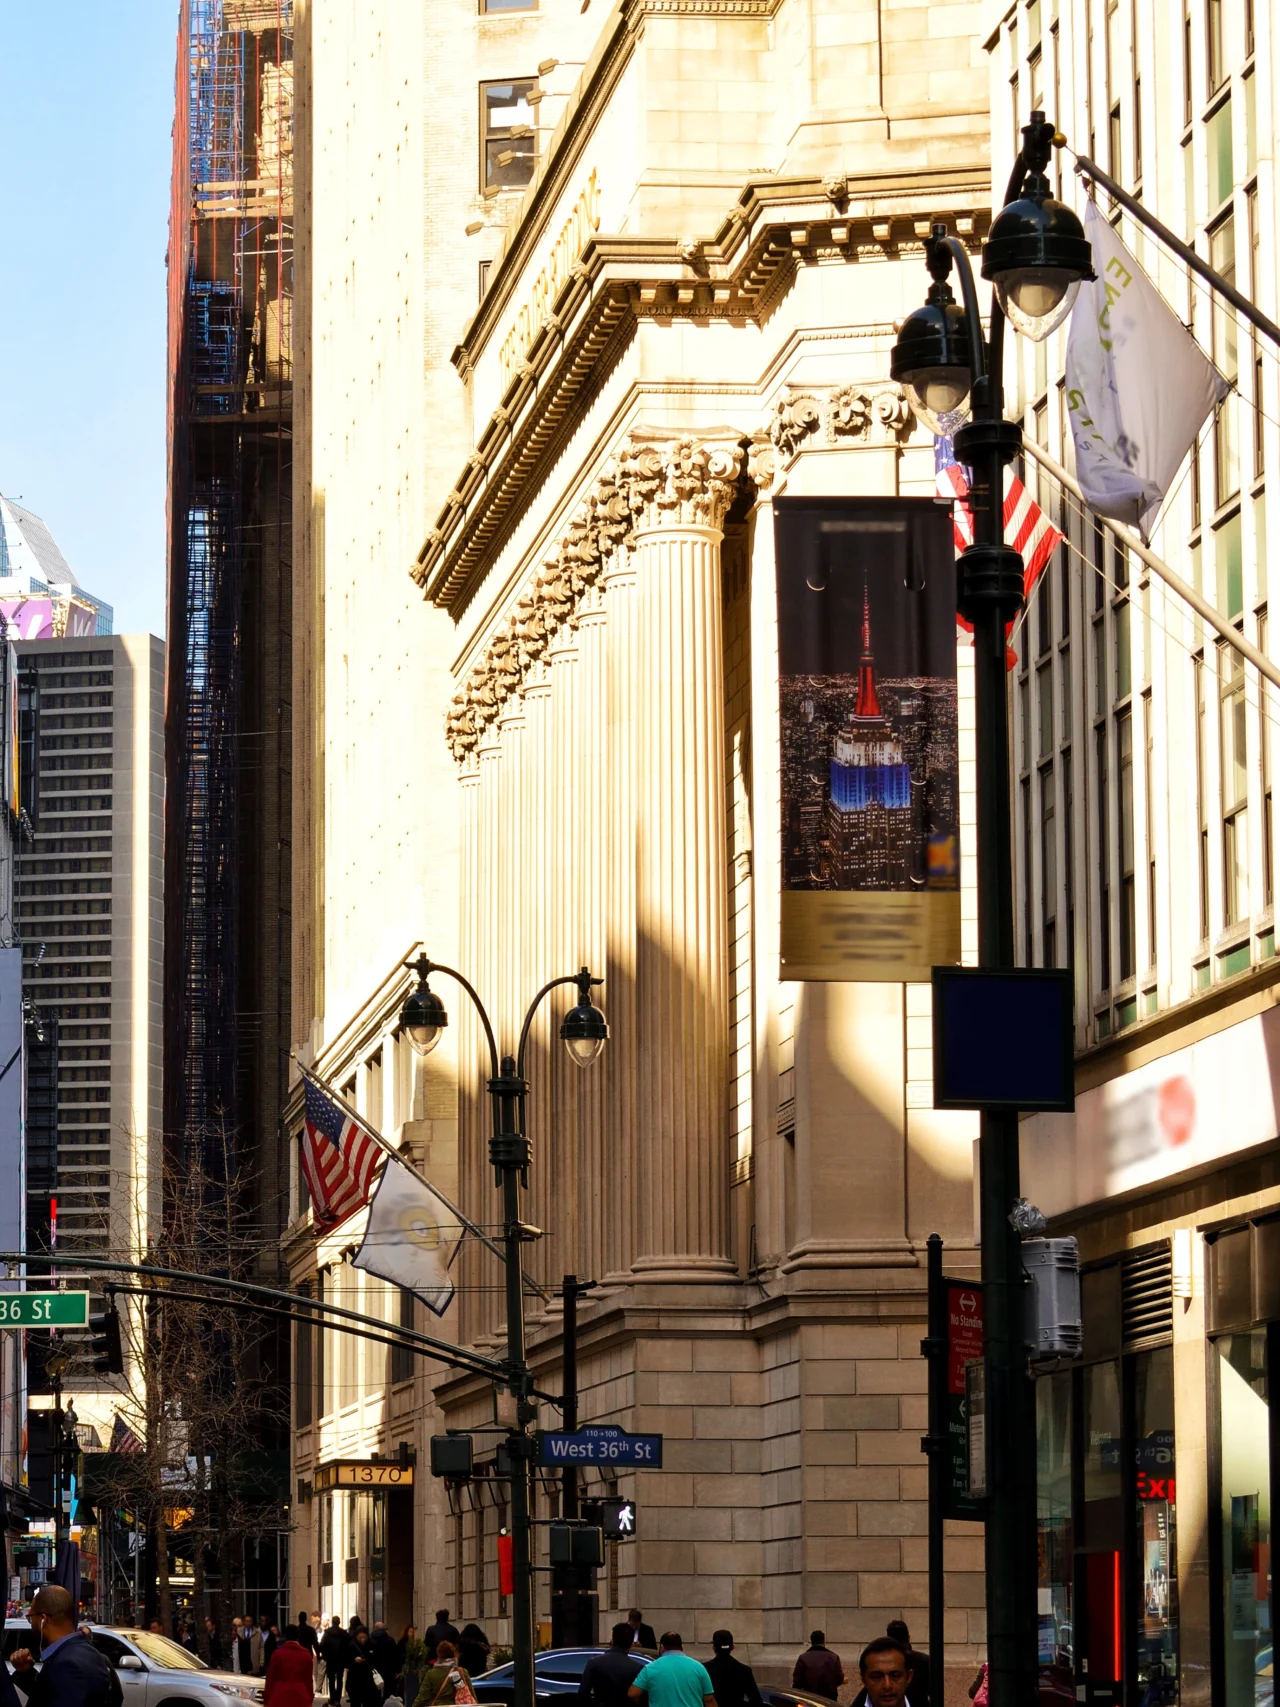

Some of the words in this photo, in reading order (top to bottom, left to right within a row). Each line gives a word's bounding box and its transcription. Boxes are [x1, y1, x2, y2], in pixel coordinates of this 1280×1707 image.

[31, 1299, 52, 1319] St
[951, 1313, 959, 1325] No
[960, 1315, 982, 1332] Standin
[551, 1440, 594, 1457] West
[598, 1441, 629, 1458] 36th
[634, 1442, 651, 1459] St
[350, 1467, 402, 1482] 1370
